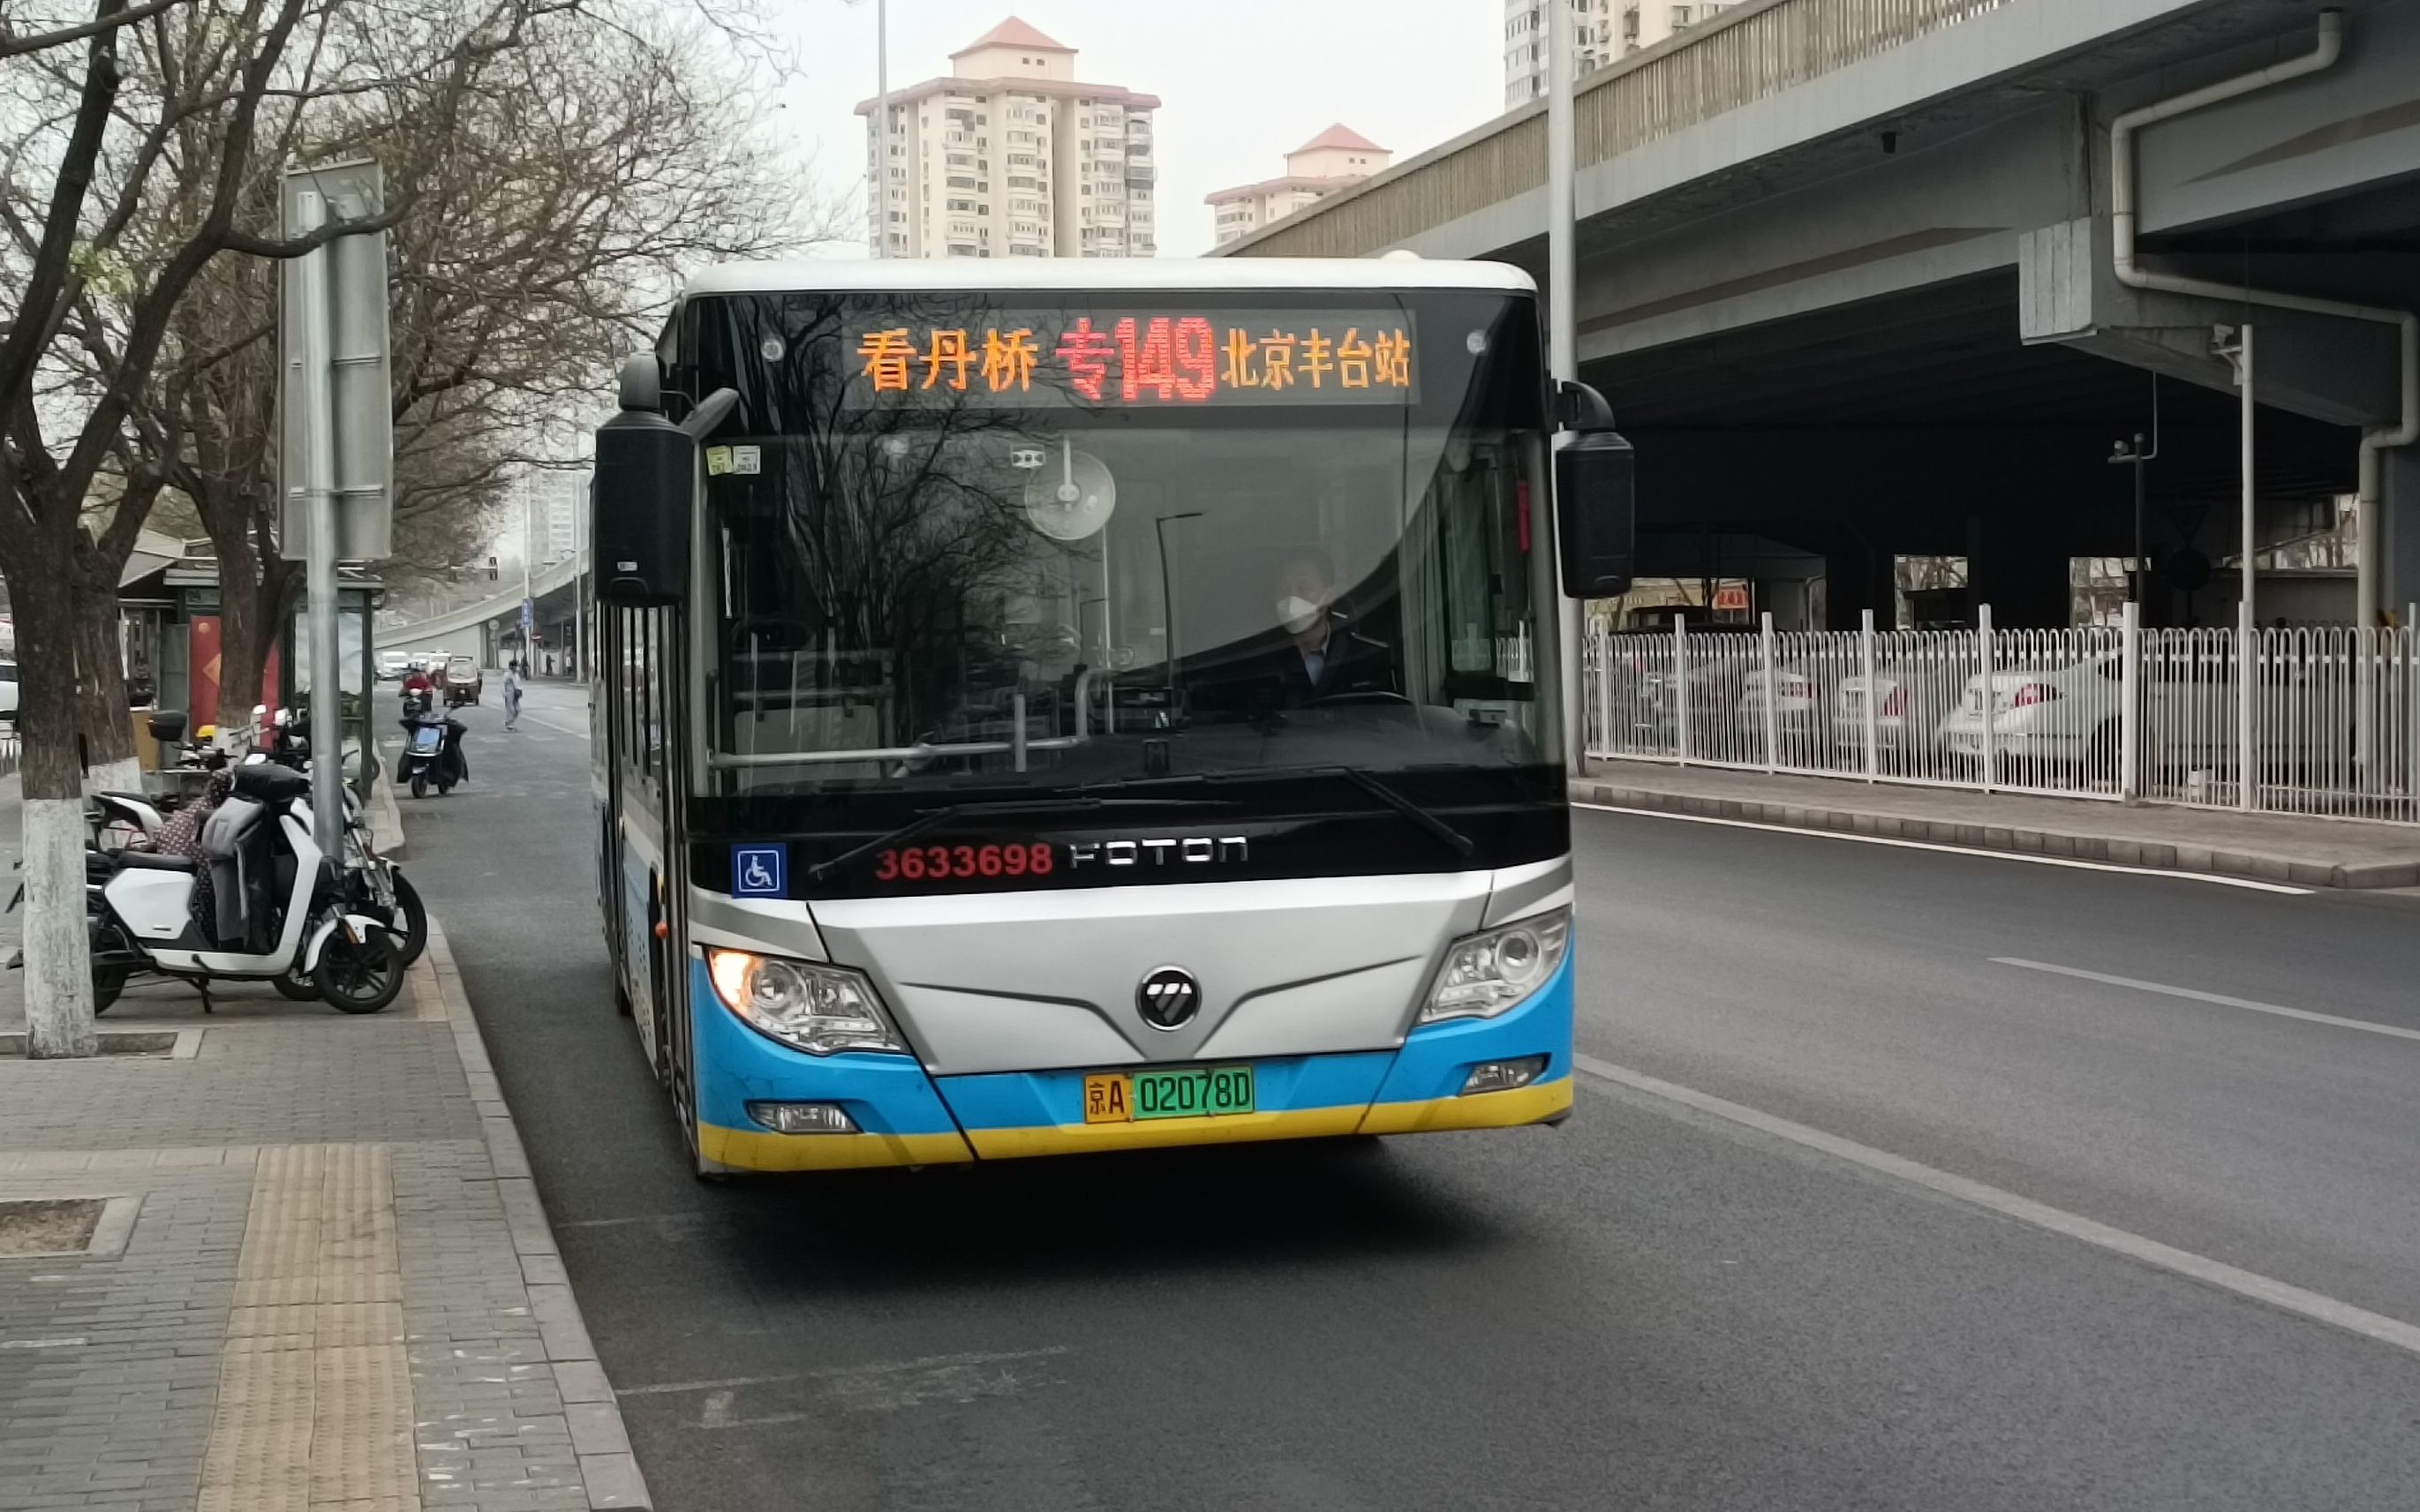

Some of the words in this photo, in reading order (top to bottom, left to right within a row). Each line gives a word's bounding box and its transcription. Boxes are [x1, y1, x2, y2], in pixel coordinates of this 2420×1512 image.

[856, 327, 1039, 393] 看丹桥
[1055, 317, 1217, 401] 专149
[1220, 327, 1411, 390] 北京丰台站
[875, 843, 1053, 880] 3633698
[1069, 836, 1248, 869] FOTON
[1089, 1081, 1125, 1115] 京A
